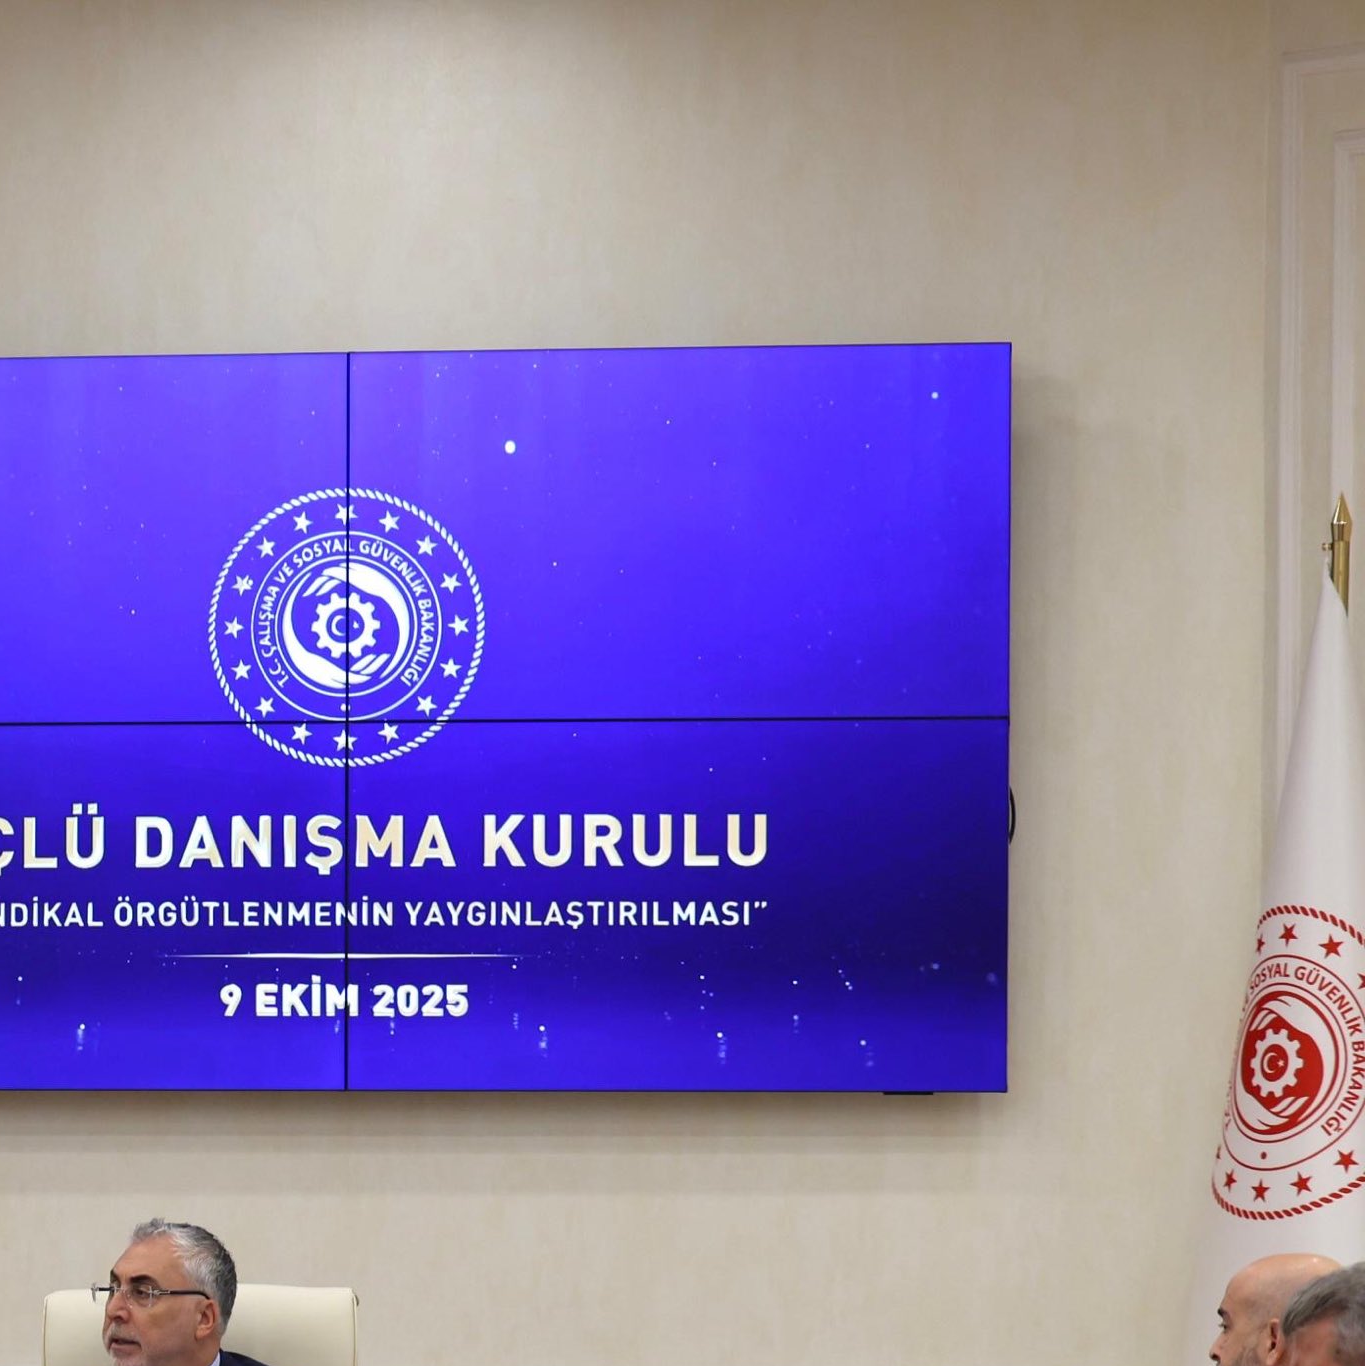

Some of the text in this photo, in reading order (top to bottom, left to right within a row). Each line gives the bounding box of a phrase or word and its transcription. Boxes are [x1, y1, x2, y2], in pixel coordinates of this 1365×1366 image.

[257, 585, 281, 659] ÇALIŞMA
[274, 561, 294, 584] VE
[292, 538, 353, 569] SOSYAL
[359, 540, 429, 599] GÜVENLİK
[400, 598, 435, 687] BAKANLIĞI
[134, 814, 457, 875] DANIŞMA
[482, 813, 768, 867] KURULU
[113, 895, 394, 927] ÖRGÜTLENMENİN
[219, 974, 469, 1017] 9 EKİM 2025
[1294, 965, 1363, 1037] GÜVENLİK
[1320, 1040, 1365, 1137] BAKANLIĞI
